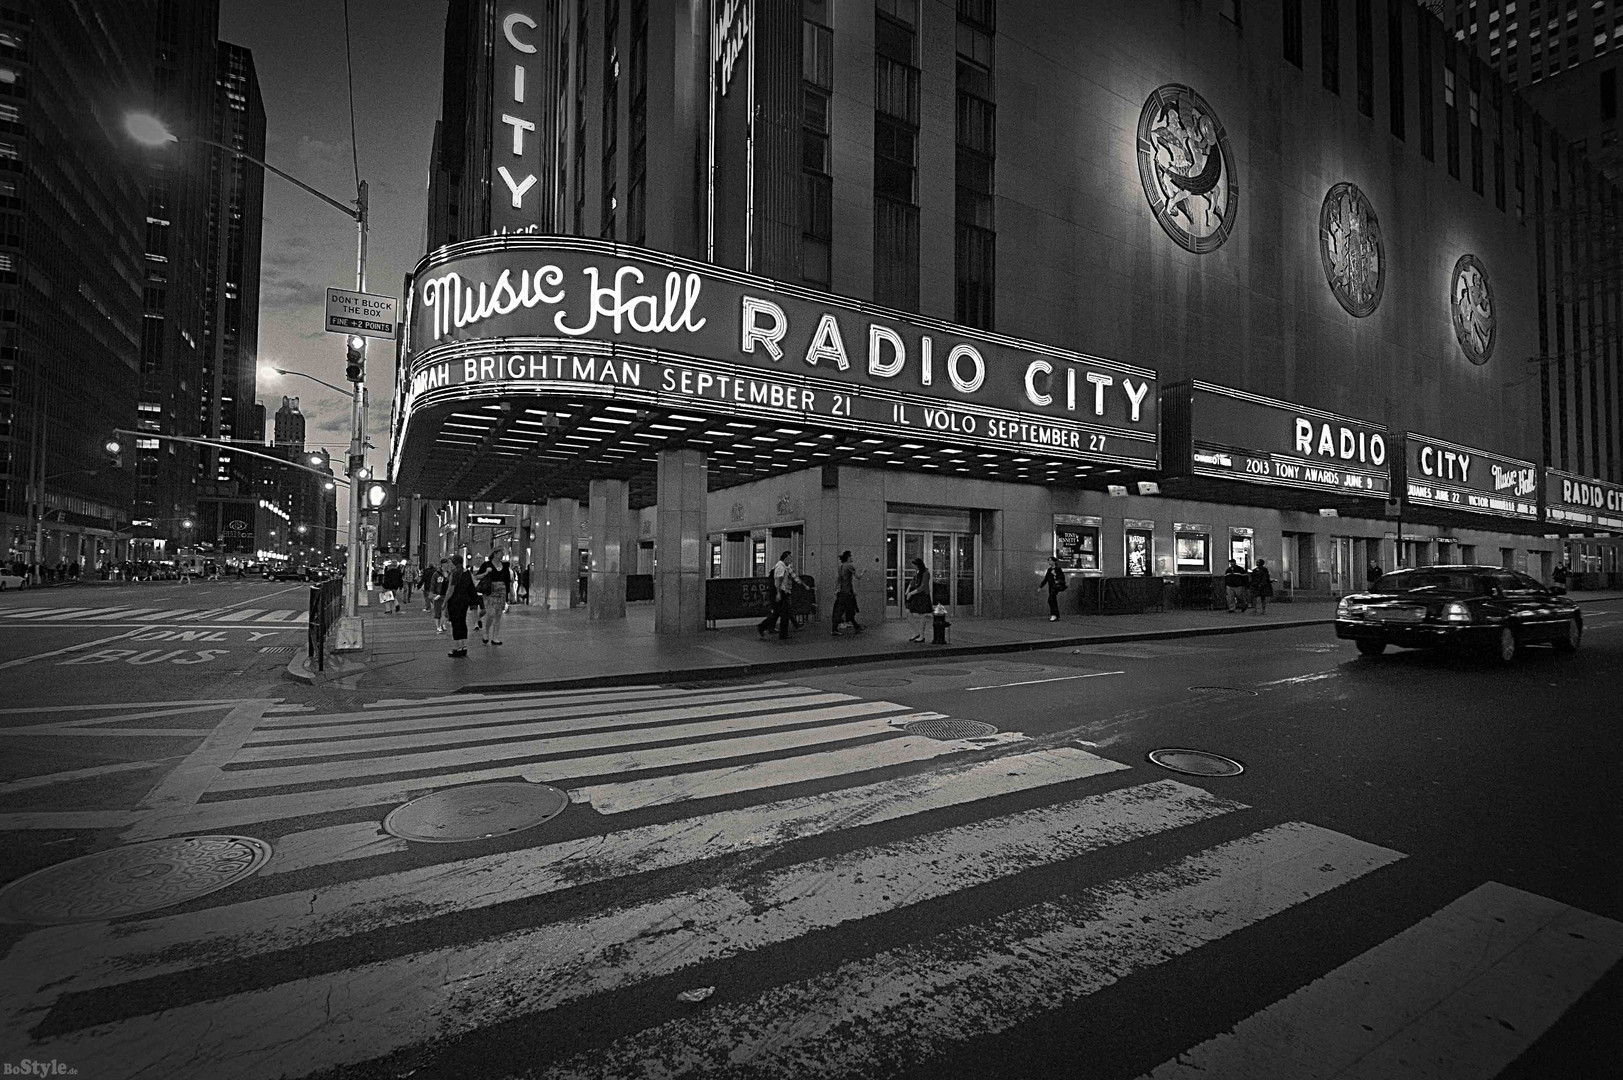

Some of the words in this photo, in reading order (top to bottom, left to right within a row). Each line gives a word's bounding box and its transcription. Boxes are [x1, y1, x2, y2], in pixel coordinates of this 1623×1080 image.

[497, 12, 538, 209] CITY
[331, 294, 359, 305] DON'T
[361, 299, 392, 310] BLOCK
[343, 305, 361, 315] THE
[363, 308, 381, 317] BOX
[423, 264, 566, 340] Music
[553, 265, 707, 336] Hall
[332, 317, 349, 326] FINE
[351, 320, 363, 328] +2
[365, 321, 390, 331] POINTS
[741, 294, 987, 395] RADIO
[1023, 359, 1149, 423] CITY
[464, 355, 641, 386] BRIGHTMAN
[662, 368, 814, 411] SEPTEMBER
[832, 395, 852, 417] 21
[893, 403, 910, 424] IL
[924, 408, 976, 434] VOLO
[988, 418, 1079, 448] SEPTEMBER
[1089, 435, 1107, 452] 27
[1296, 417, 1386, 466] RADIO
[1246, 459, 1270, 475] 2013
[1275, 463, 1300, 479] TONY
[1305, 468, 1339, 485] AWARDS
[1344, 475, 1363, 488] JUNE
[1367, 477, 1373, 489] 9
[1421, 446, 1470, 482] CITY
[1452, 492, 1460, 503] 22
[1563, 479, 1604, 508] RADIO
[1607, 489, 1623, 512] CIT
[130, 630, 279, 642] ONLY
[54, 649, 230, 665] BUS
